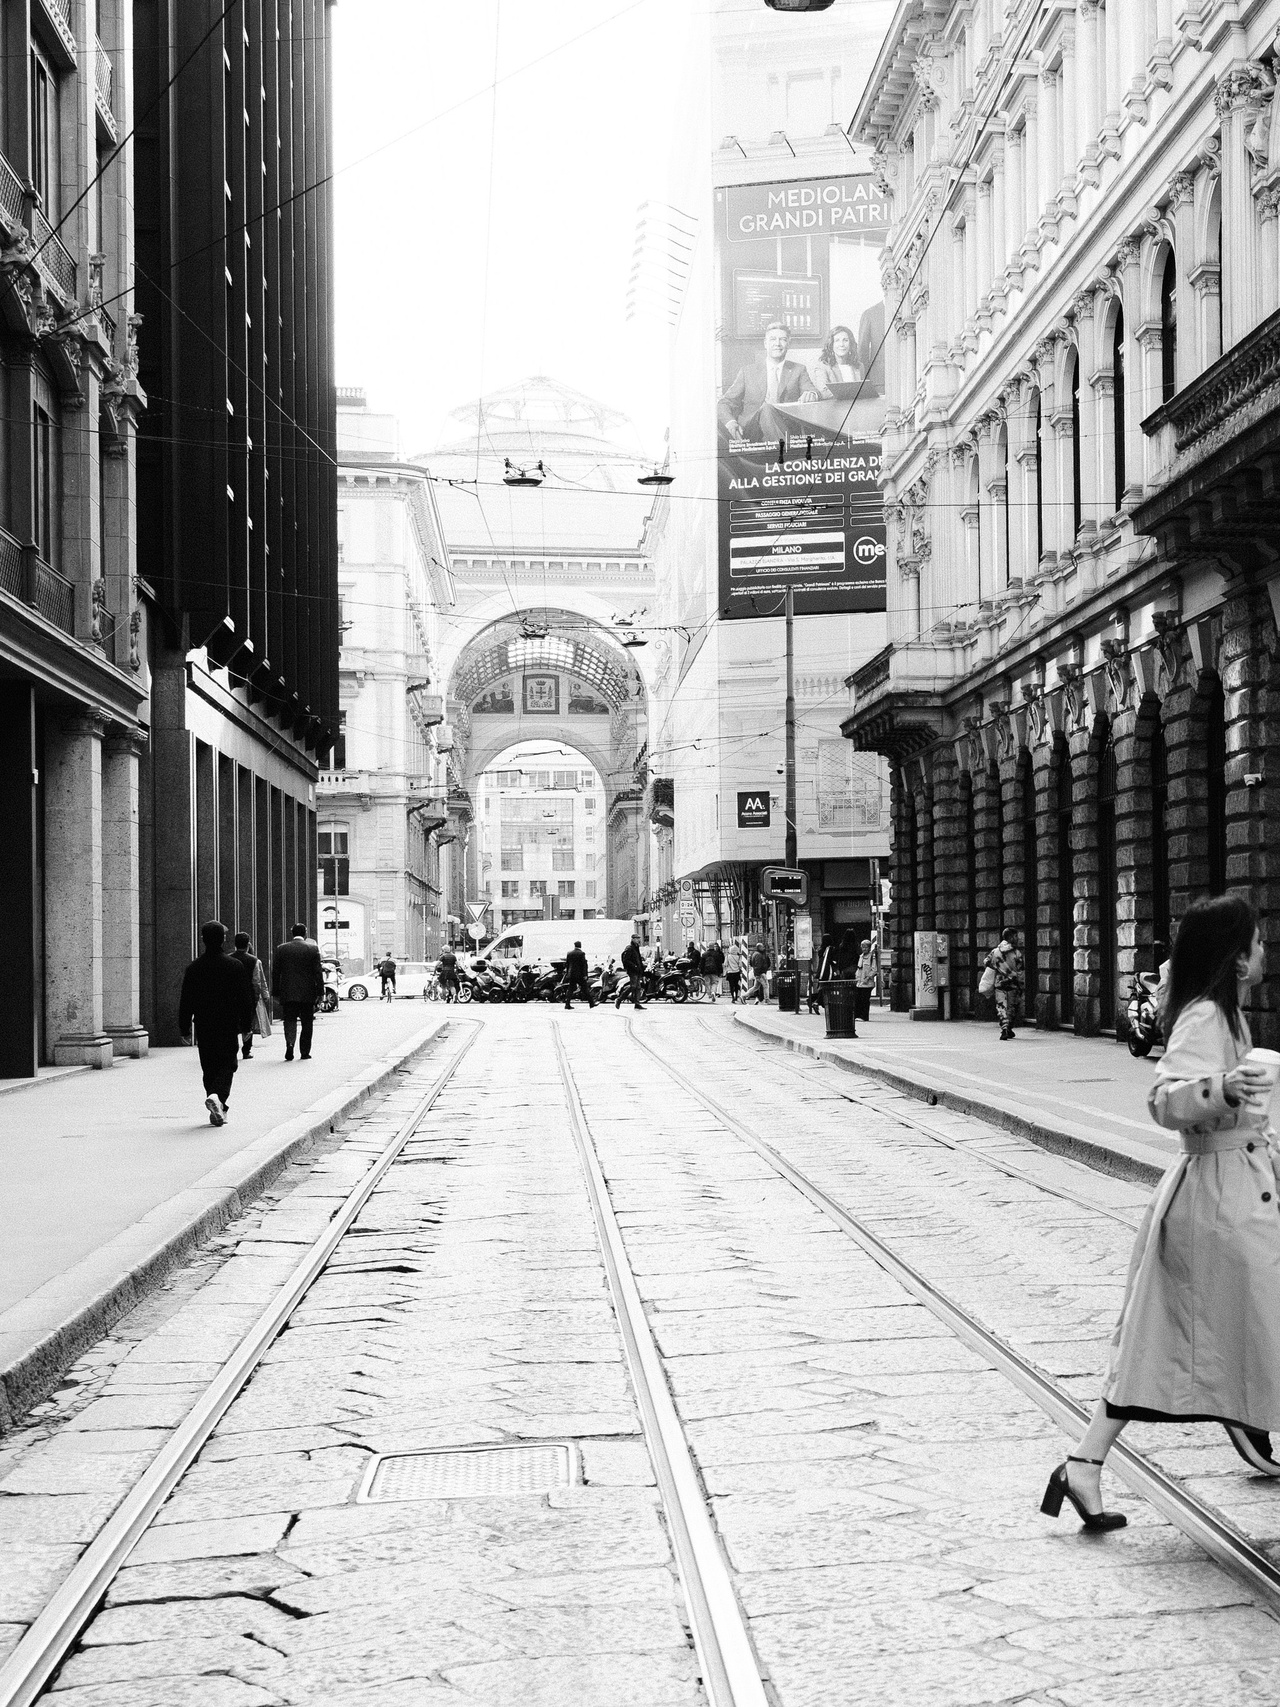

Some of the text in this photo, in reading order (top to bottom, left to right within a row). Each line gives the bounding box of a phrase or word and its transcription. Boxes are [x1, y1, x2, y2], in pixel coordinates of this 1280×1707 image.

[768, 183, 884, 209] MEDIOLAN
[739, 208, 823, 233] GRANDI
[765, 462, 781, 473] LA
[783, 457, 866, 472] CONSULENZA
[728, 477, 760, 490] ALLA
[762, 473, 823, 488] GESTIONE
[825, 471, 845, 483] DEI
[771, 545, 802, 555] MILANO
